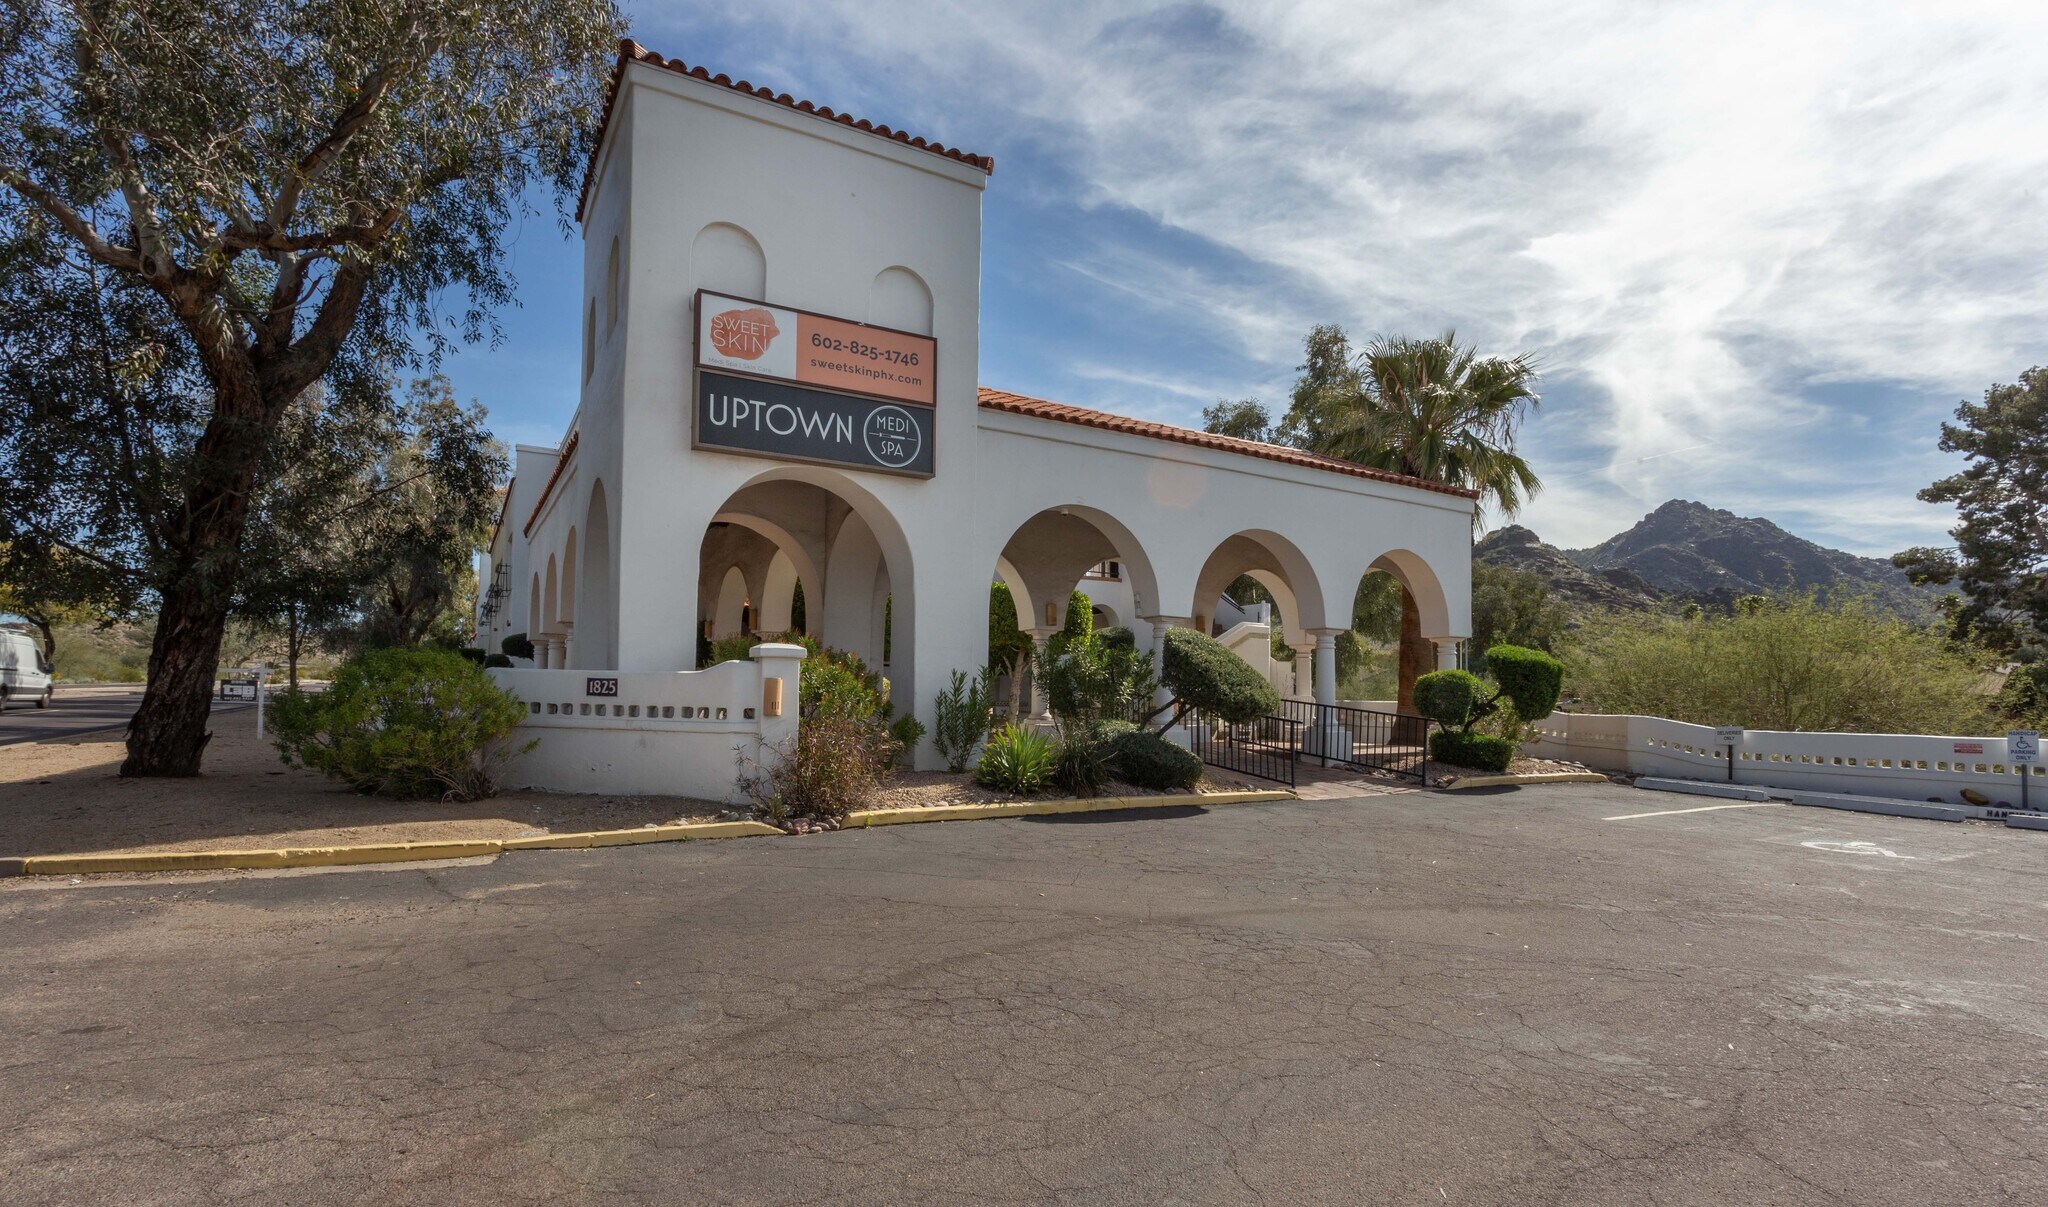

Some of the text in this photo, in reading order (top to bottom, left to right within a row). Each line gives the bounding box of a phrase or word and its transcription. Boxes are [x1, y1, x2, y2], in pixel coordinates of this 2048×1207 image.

[713, 315, 770, 337] SWEET
[713, 329, 767, 353] SKIN
[811, 333, 919, 366] 602-825-1746
[810, 358, 922, 386] sweetskinphx.com
[709, 393, 853, 444] UPTOWN
[876, 415, 909, 433] MEDI
[881, 441, 904, 457] SPA
[589, 680, 616, 694] 1825
